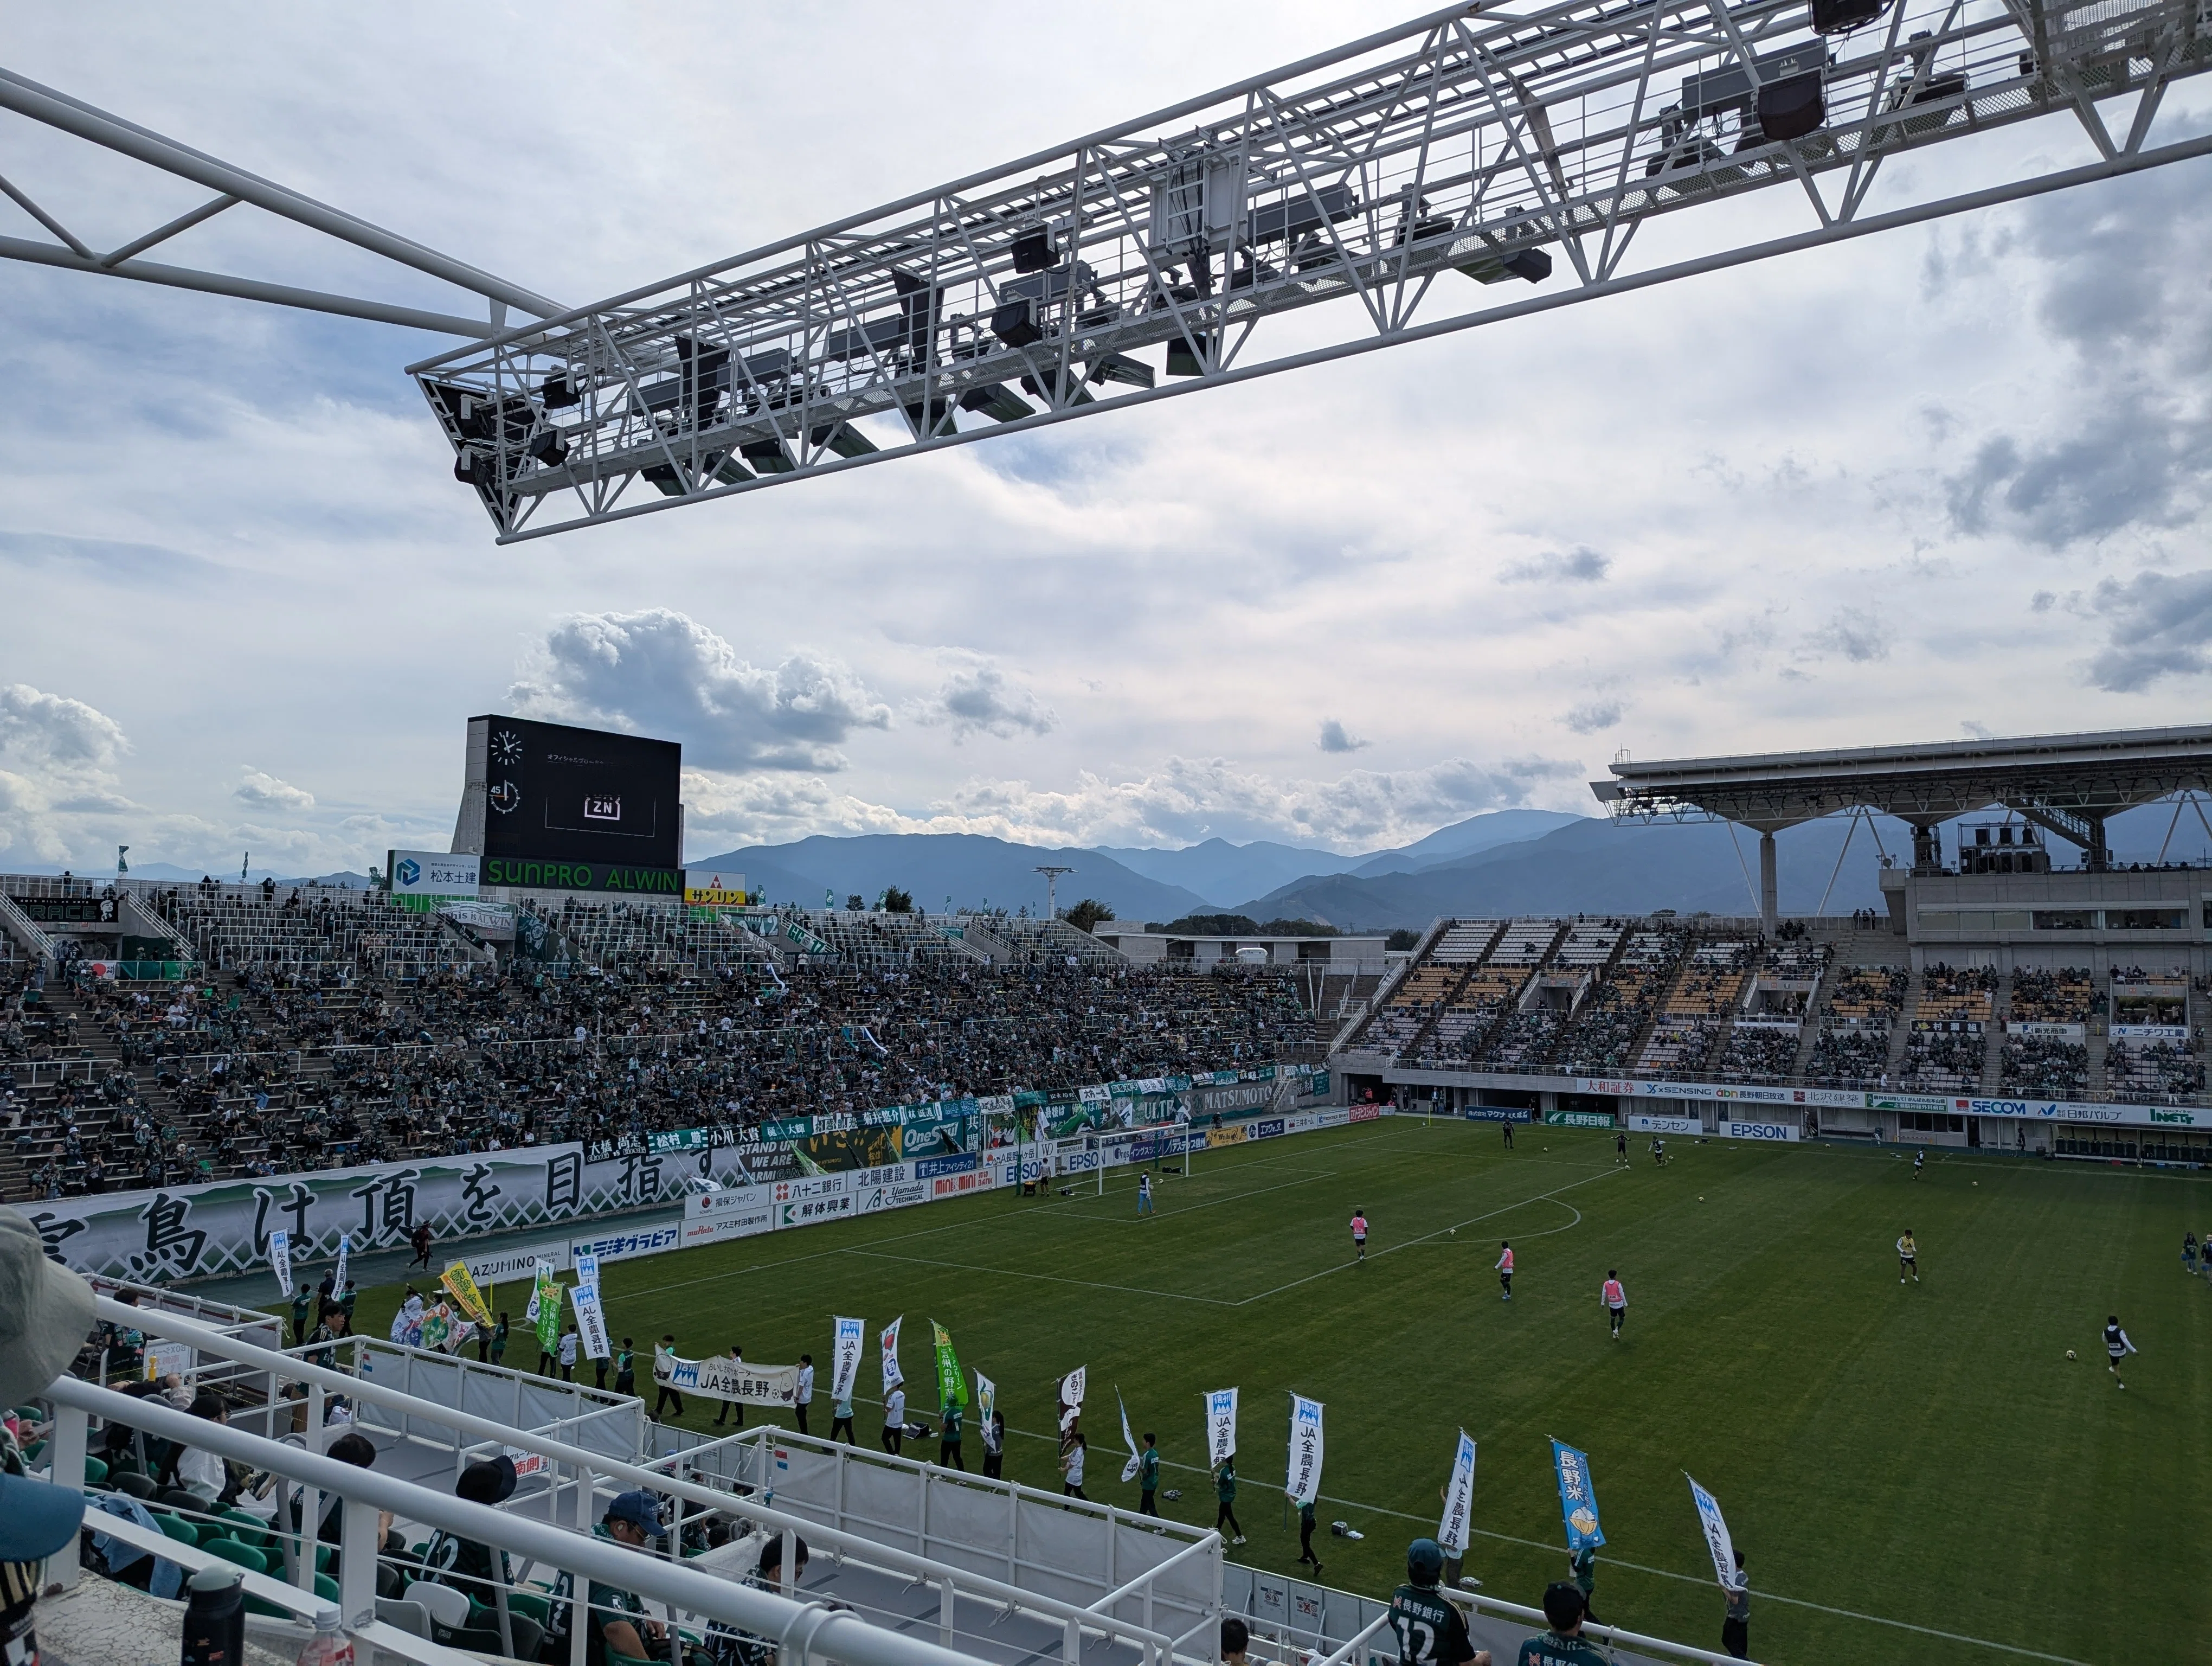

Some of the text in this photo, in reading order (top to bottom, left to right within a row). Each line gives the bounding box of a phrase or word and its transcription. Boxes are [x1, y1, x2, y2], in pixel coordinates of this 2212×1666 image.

[491, 786, 500, 794] 45
[430, 869, 477, 884] 松本土建
[606, 869, 678, 891] ALWIN
[691, 889, 740, 905] サンリン
[478, 915, 511, 927] ALWIN
[2133, 1028, 2187, 1037] ニチワ工業
[1586, 1080, 1635, 1094] 大和証券
[1205, 1085, 1272, 1110] MATSUMOTO
[1739, 1090, 1785, 1100] 長野朝日放送
[1806, 1092, 1860, 1102] 北沢建築
[1972, 1100, 2026, 1115] SECOM
[1296, 1117, 1314, 1127] 三井ホーム
[1564, 1114, 1610, 1127] 長野日報
[2067, 1110, 2122, 1121] 日邦バルブ
[710, 1126, 760, 1145] 小川 大貴
[786, 1123, 806, 1135] 大輝
[1731, 1124, 1787, 1139] EPSON
[589, 1135, 641, 1156] 大橋 尚志
[657, 1133, 680, 1148] 松村
[739, 1140, 777, 1156] STAND
[1041, 1143, 1053, 1156] WD
[1130, 1144, 1162, 1157] イングスシノ
[752, 1154, 793, 1168] WE ARE
[929, 1159, 974, 1175] 井上アイシティ21
[858, 1165, 905, 1188] 北陽建設
[792, 1178, 841, 1199] 八十二銀行
[887, 1182, 924, 1201] Yamada
[715, 1193, 756, 1208] 損保ジャパン
[895, 1194, 924, 1204] TECHNICAL
[801, 1197, 850, 1218] 解体興業
[716, 1214, 768, 1231] アズミ村田製作所
[593, 1229, 677, 1258] 三洋グラビア
[472, 1256, 535, 1278] AZUMINO
[537, 1251, 561, 1259] MINERAL
[842, 1322, 858, 1330] 信州
[678, 1362, 699, 1373] 信州
[700, 1373, 769, 1398] JA全農長野
[1214, 1394, 1231, 1405] 信州
[1301, 1401, 1317, 1417] 信州
[515, 1455, 540, 1476] 南側
[1294, 1426, 1316, 1496] JA全農長野
[1559, 1450, 1585, 1502] 長野米
[1402, 1598, 1445, 1623] 長野銀行
[1397, 1615, 1438, 1666] 12
